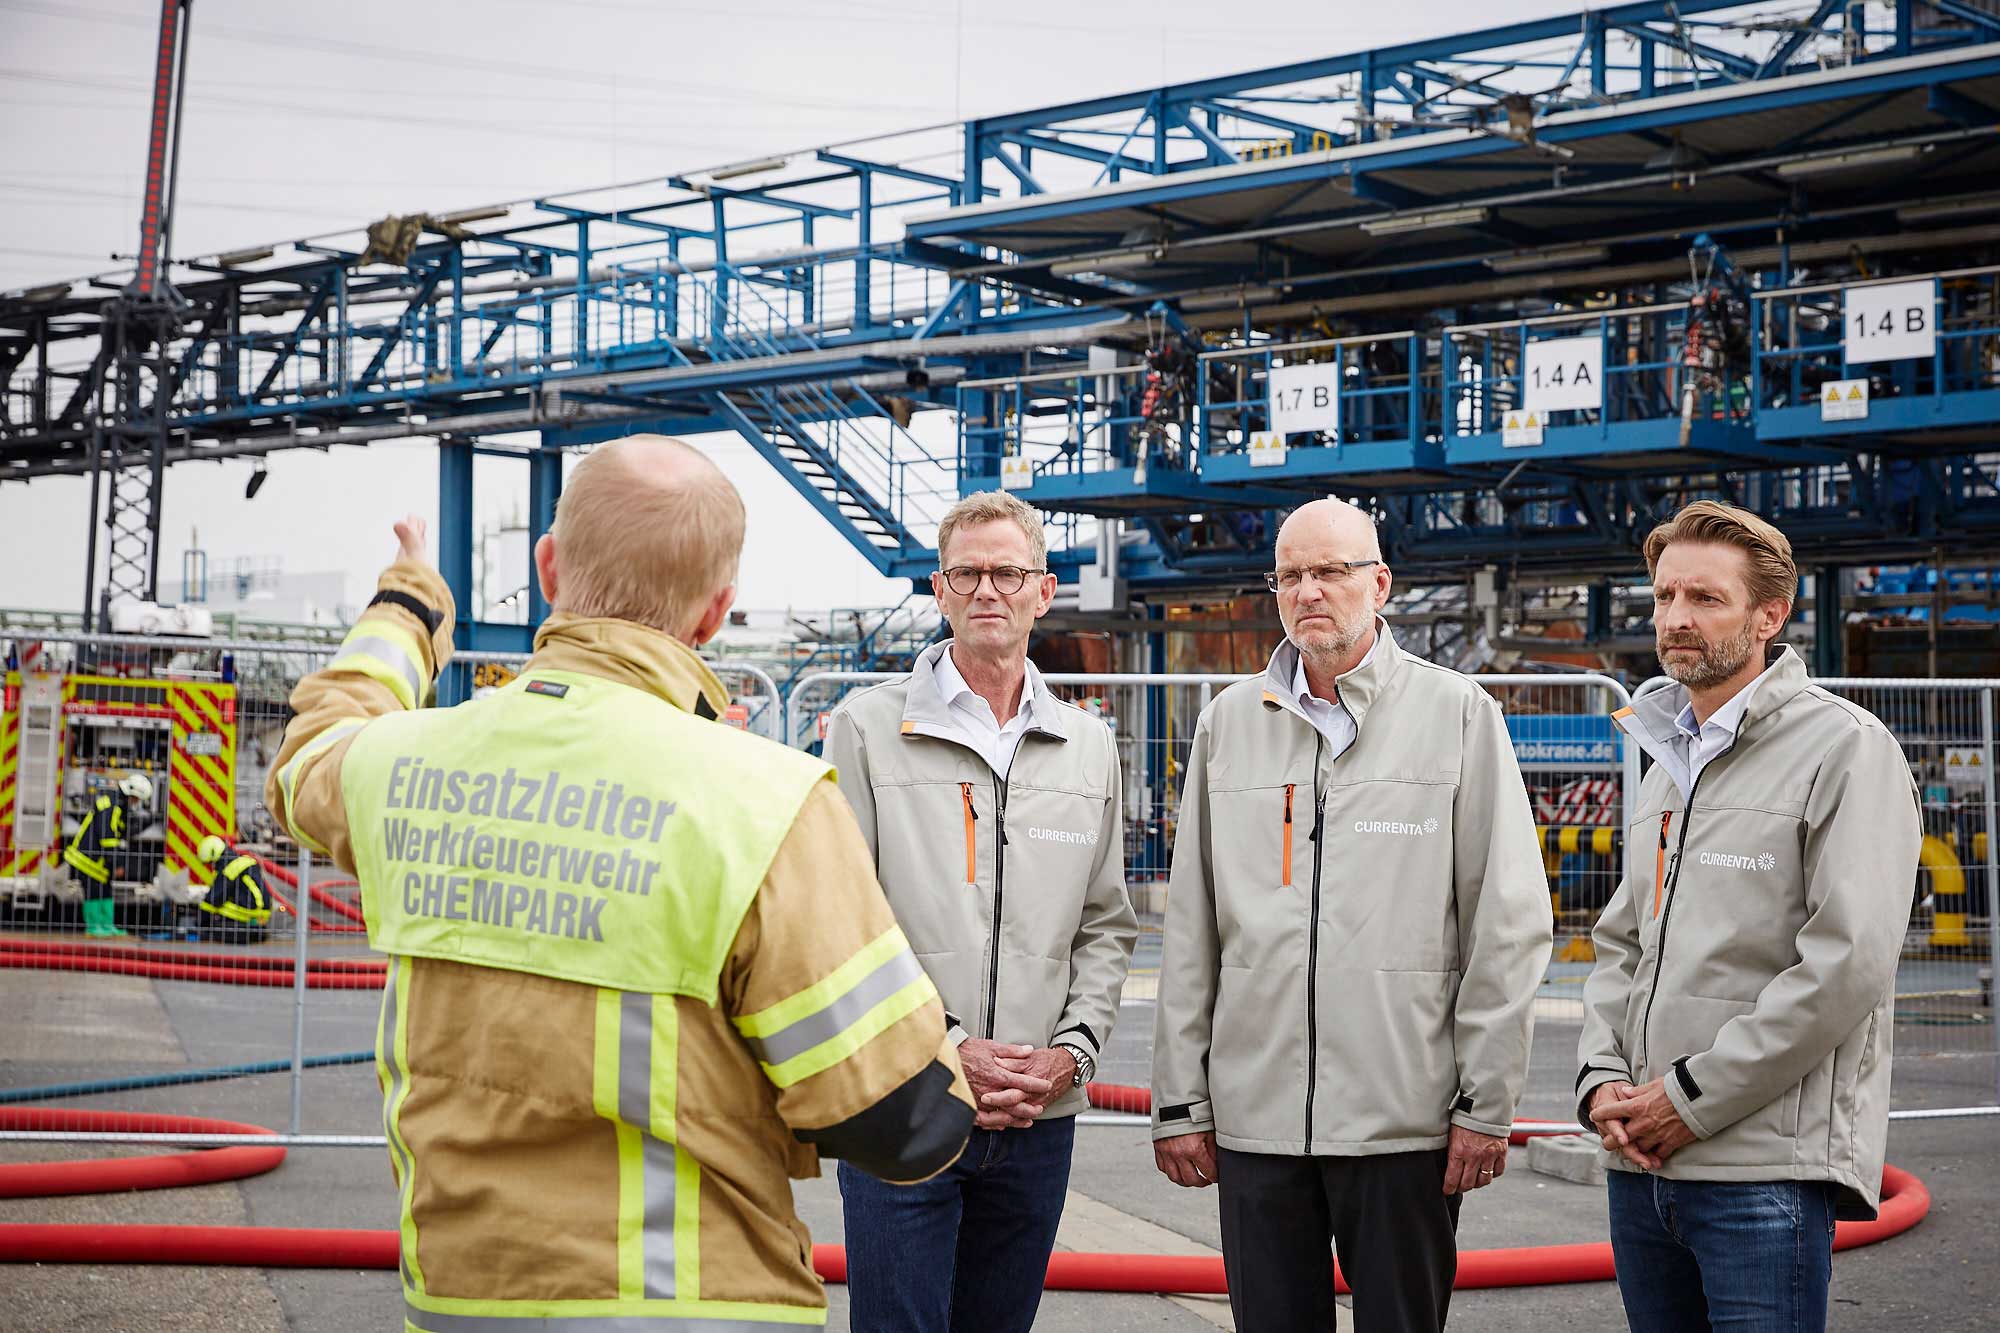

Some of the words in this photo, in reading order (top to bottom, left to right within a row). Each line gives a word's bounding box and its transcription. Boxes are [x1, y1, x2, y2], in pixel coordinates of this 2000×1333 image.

[1855, 310, 1893, 337] 1.4
[1906, 307, 1925, 332] B
[1532, 363, 1564, 388] 1.4
[1573, 362, 1592, 385] A
[1277, 388, 1302, 411] 1.7
[1314, 386, 1329, 407] B
[386, 757, 677, 843] Einsatzleiter
[1028, 827, 1087, 845] CURRENTA
[1354, 821, 1423, 836] CURRENTA
[384, 817, 661, 896] Werkfeuerwehr
[1700, 852, 1757, 871] CURRENTA
[403, 871, 608, 942] CHEMPARK
